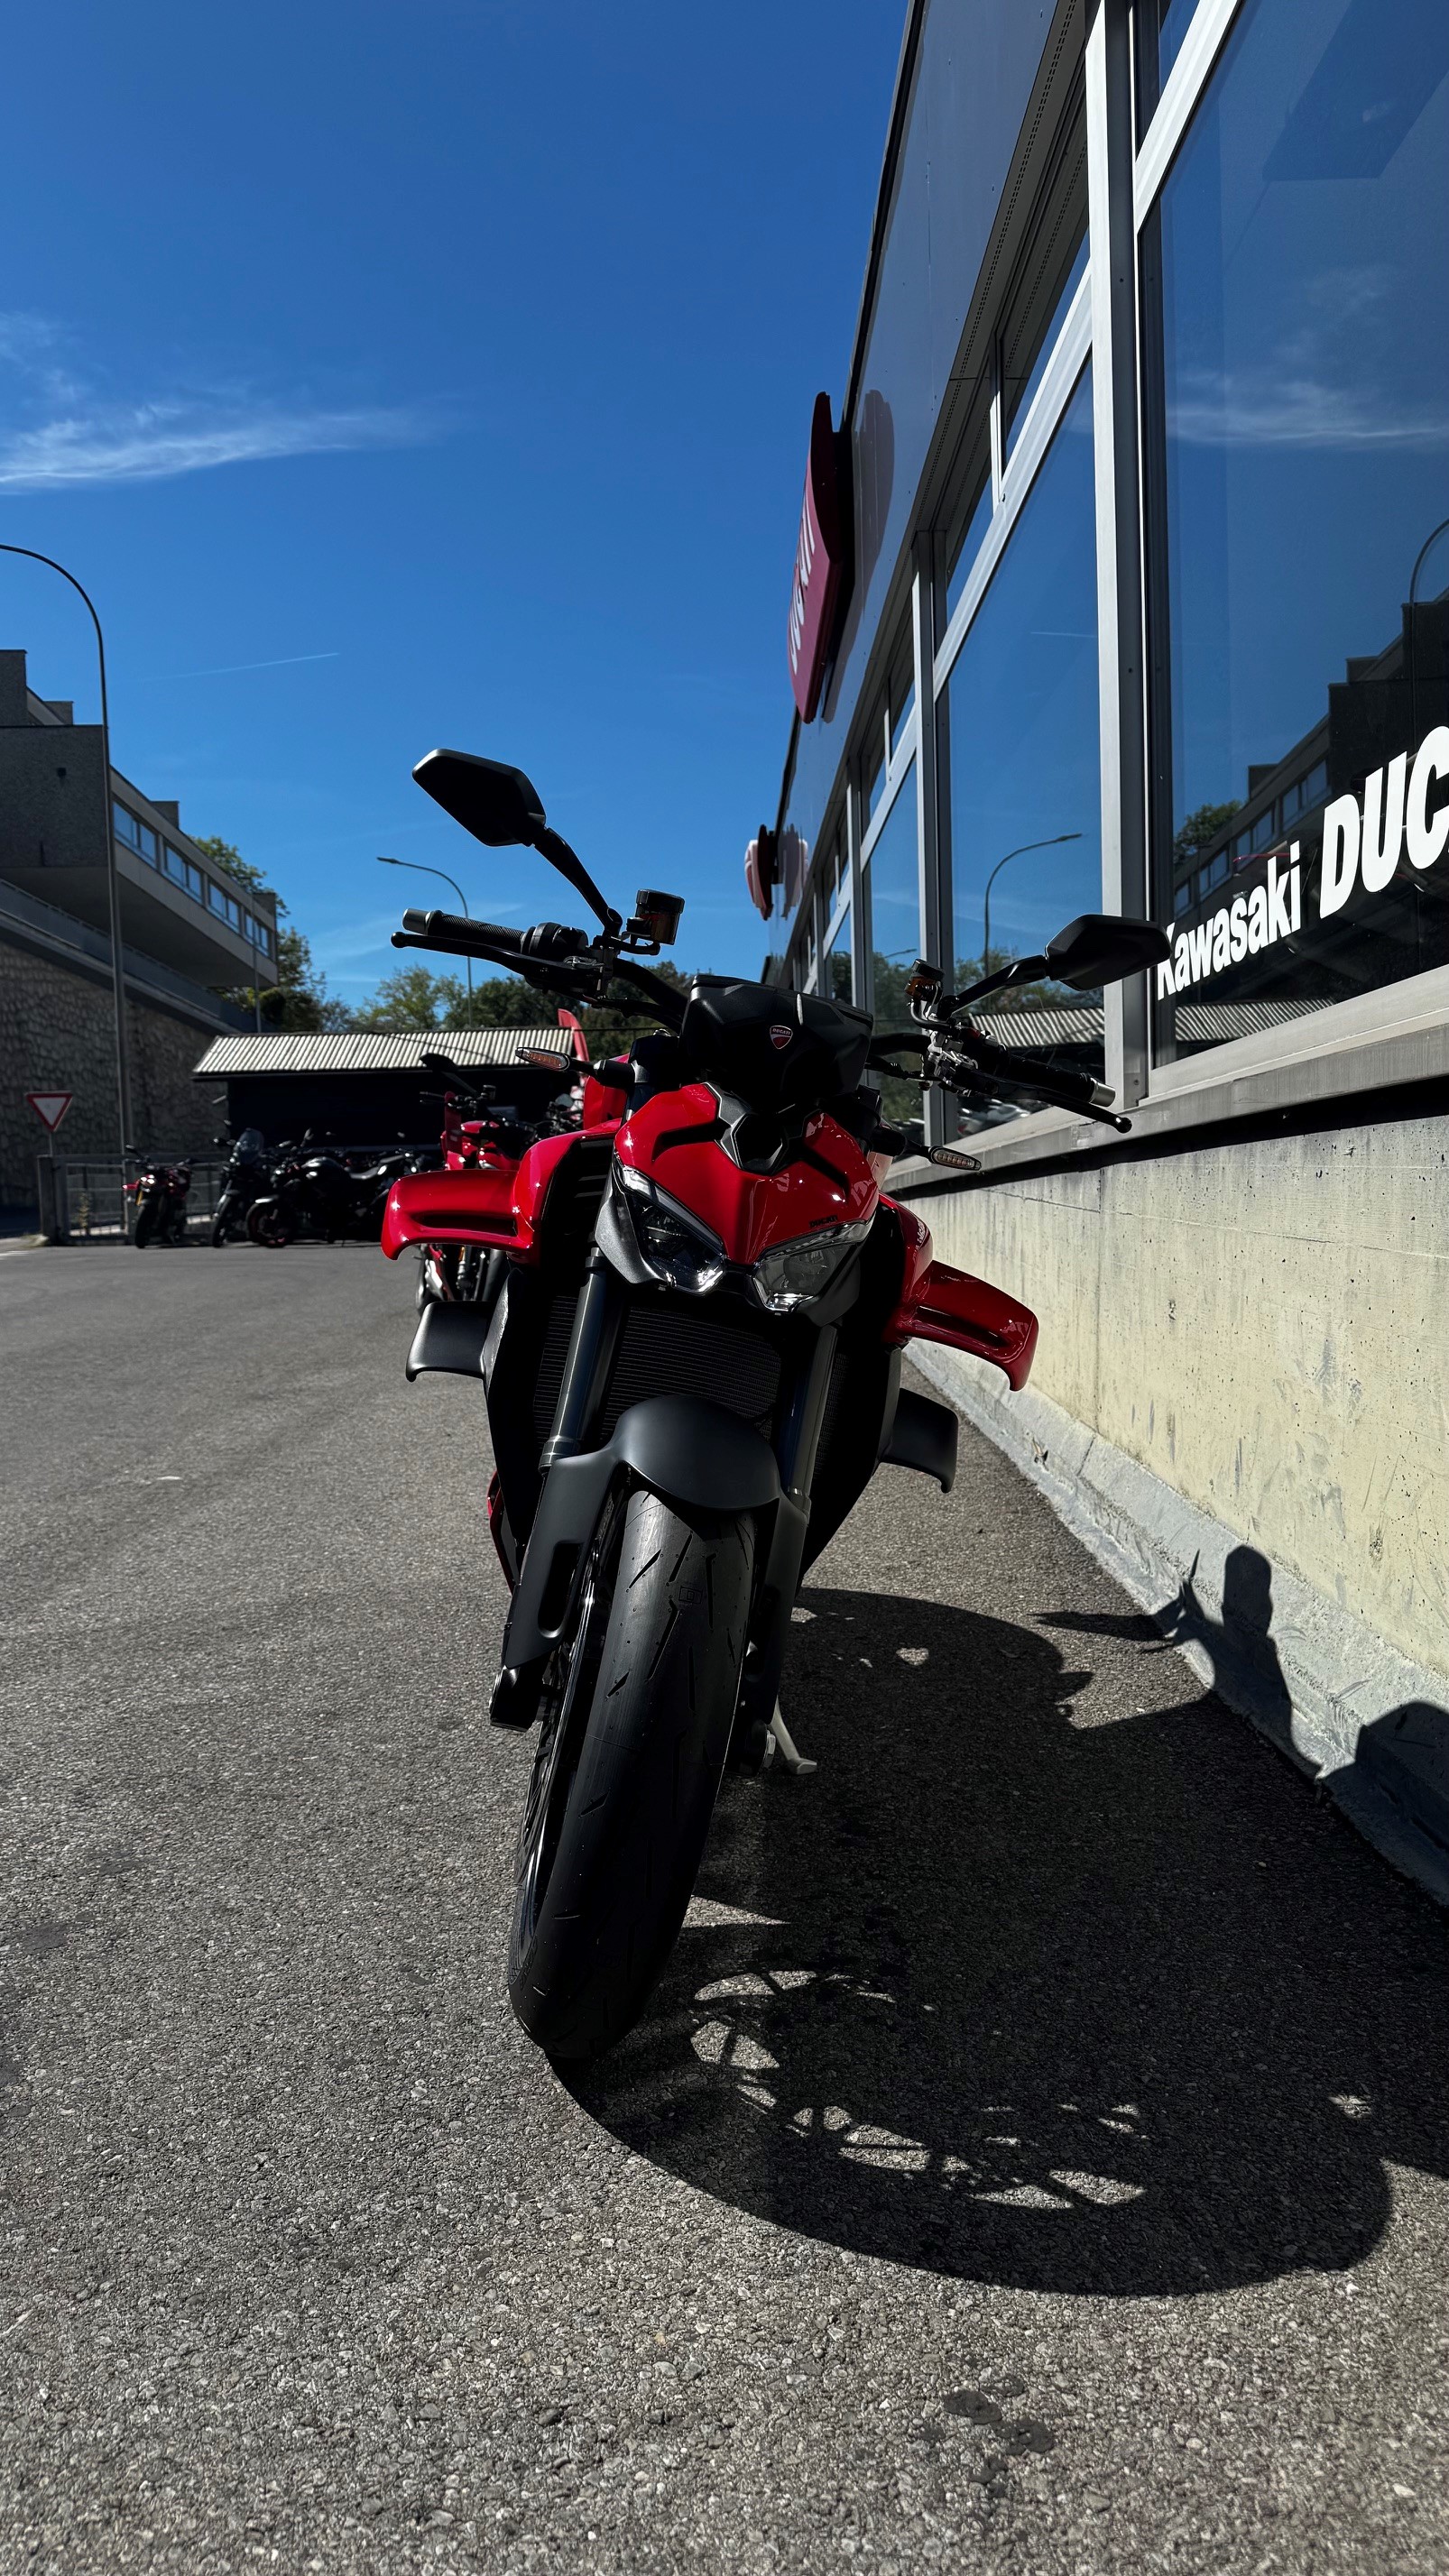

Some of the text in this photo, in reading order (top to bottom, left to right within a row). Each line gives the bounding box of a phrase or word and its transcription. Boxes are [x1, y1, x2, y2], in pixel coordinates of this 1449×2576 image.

[1157, 725, 1449, 1001] Kawasaki DUC
[772, 1027, 791, 1035] DUCATI
[808, 1214, 838, 1228] DUCATI
